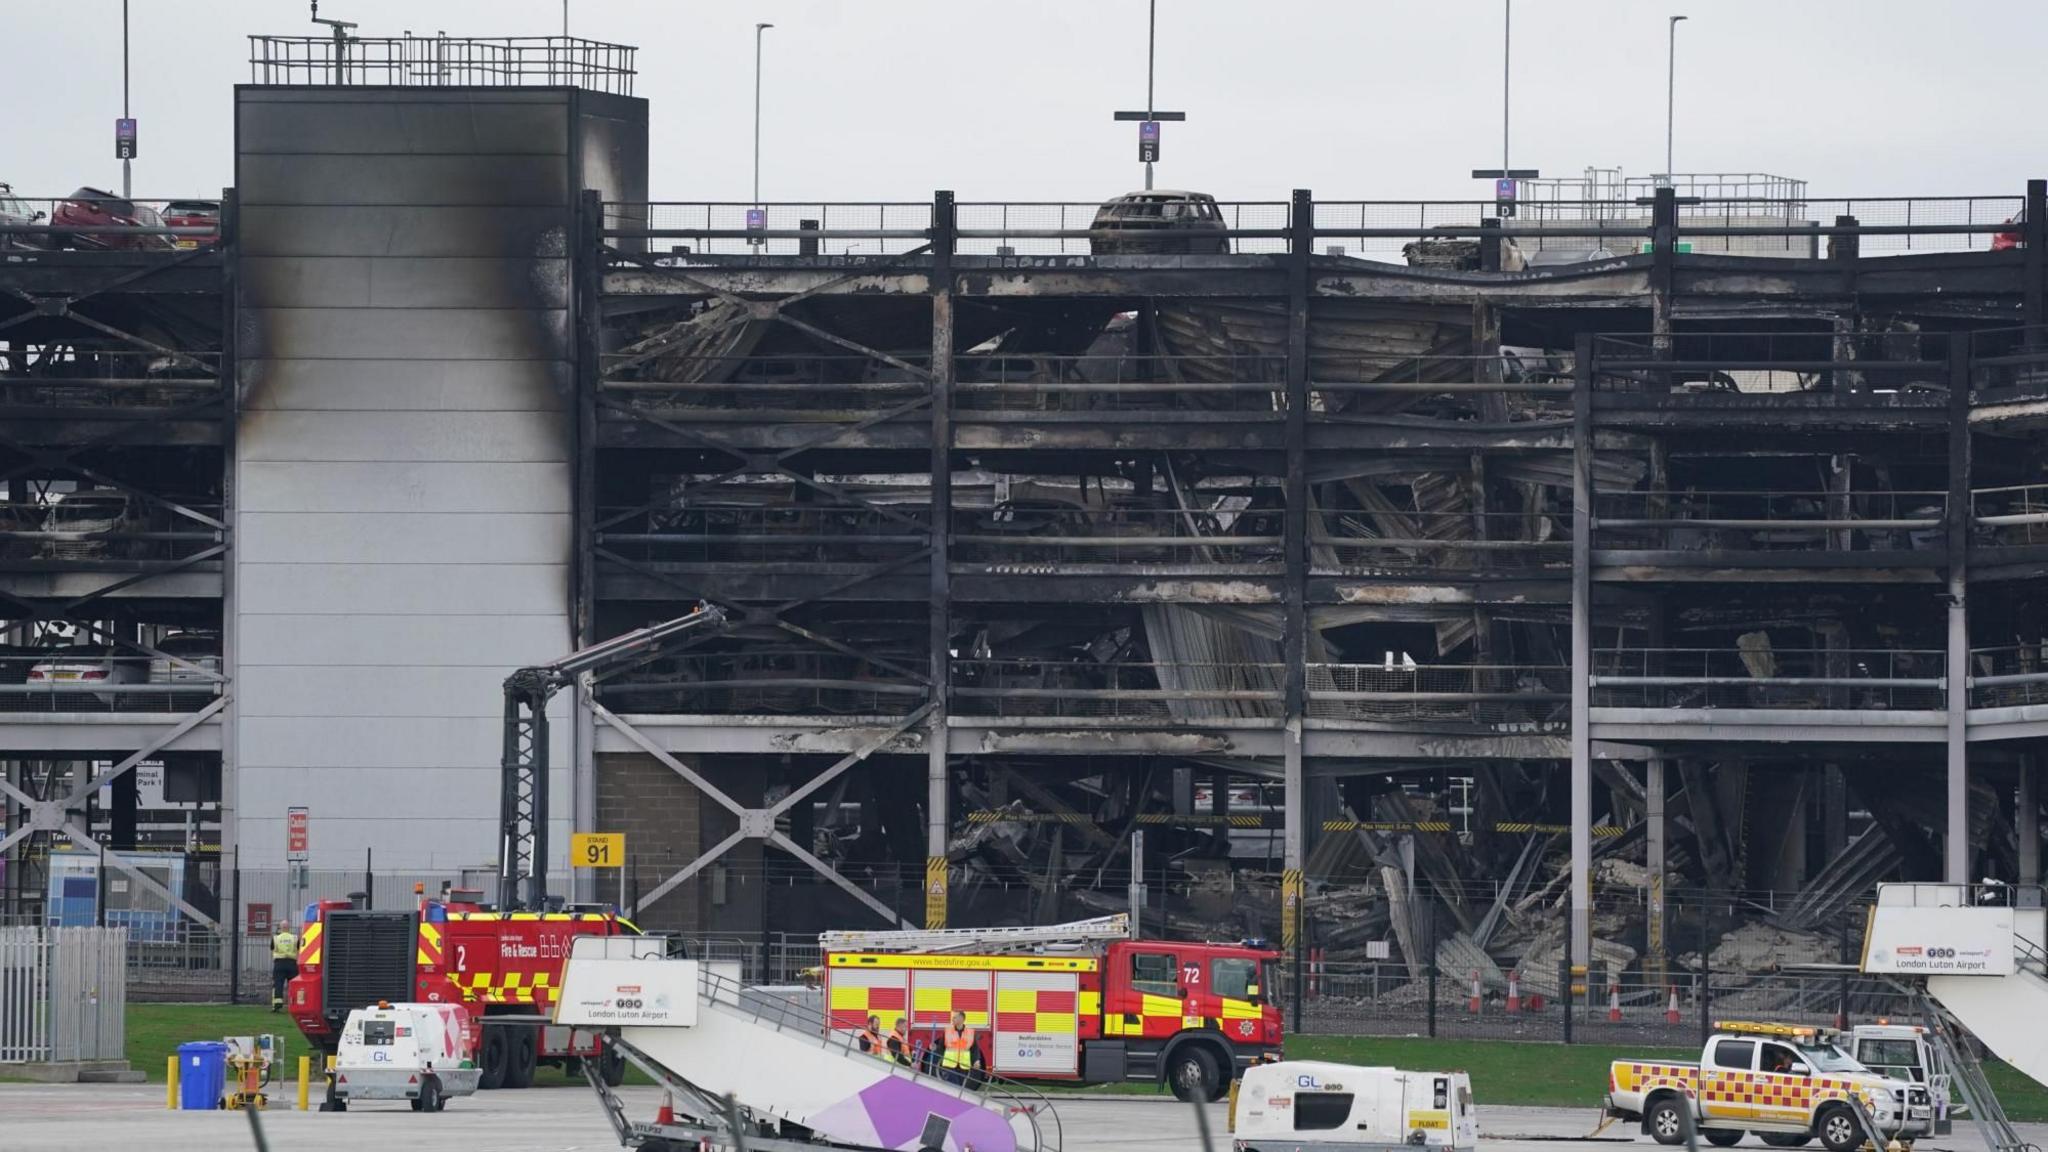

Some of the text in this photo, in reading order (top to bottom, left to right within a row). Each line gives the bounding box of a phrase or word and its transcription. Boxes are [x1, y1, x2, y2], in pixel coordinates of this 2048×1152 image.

[121, 147, 130, 158] B
[1145, 150, 1152, 161] B
[1501, 205, 1510, 216] D
[587, 844, 608, 864] 91
[501, 943, 512, 958] Fire
[457, 945, 466, 972] 2
[912, 958, 992, 968] www.bedsfire.gov.uk
[1896, 960, 1986, 972] London Luton Airport
[1183, 967, 1200, 984] 72
[588, 1010, 668, 1021] London Luton Airport
[374, 1051, 393, 1062] GL
[1298, 1075, 1322, 1088] GL
[1418, 1120, 1439, 1129] FLOAT
